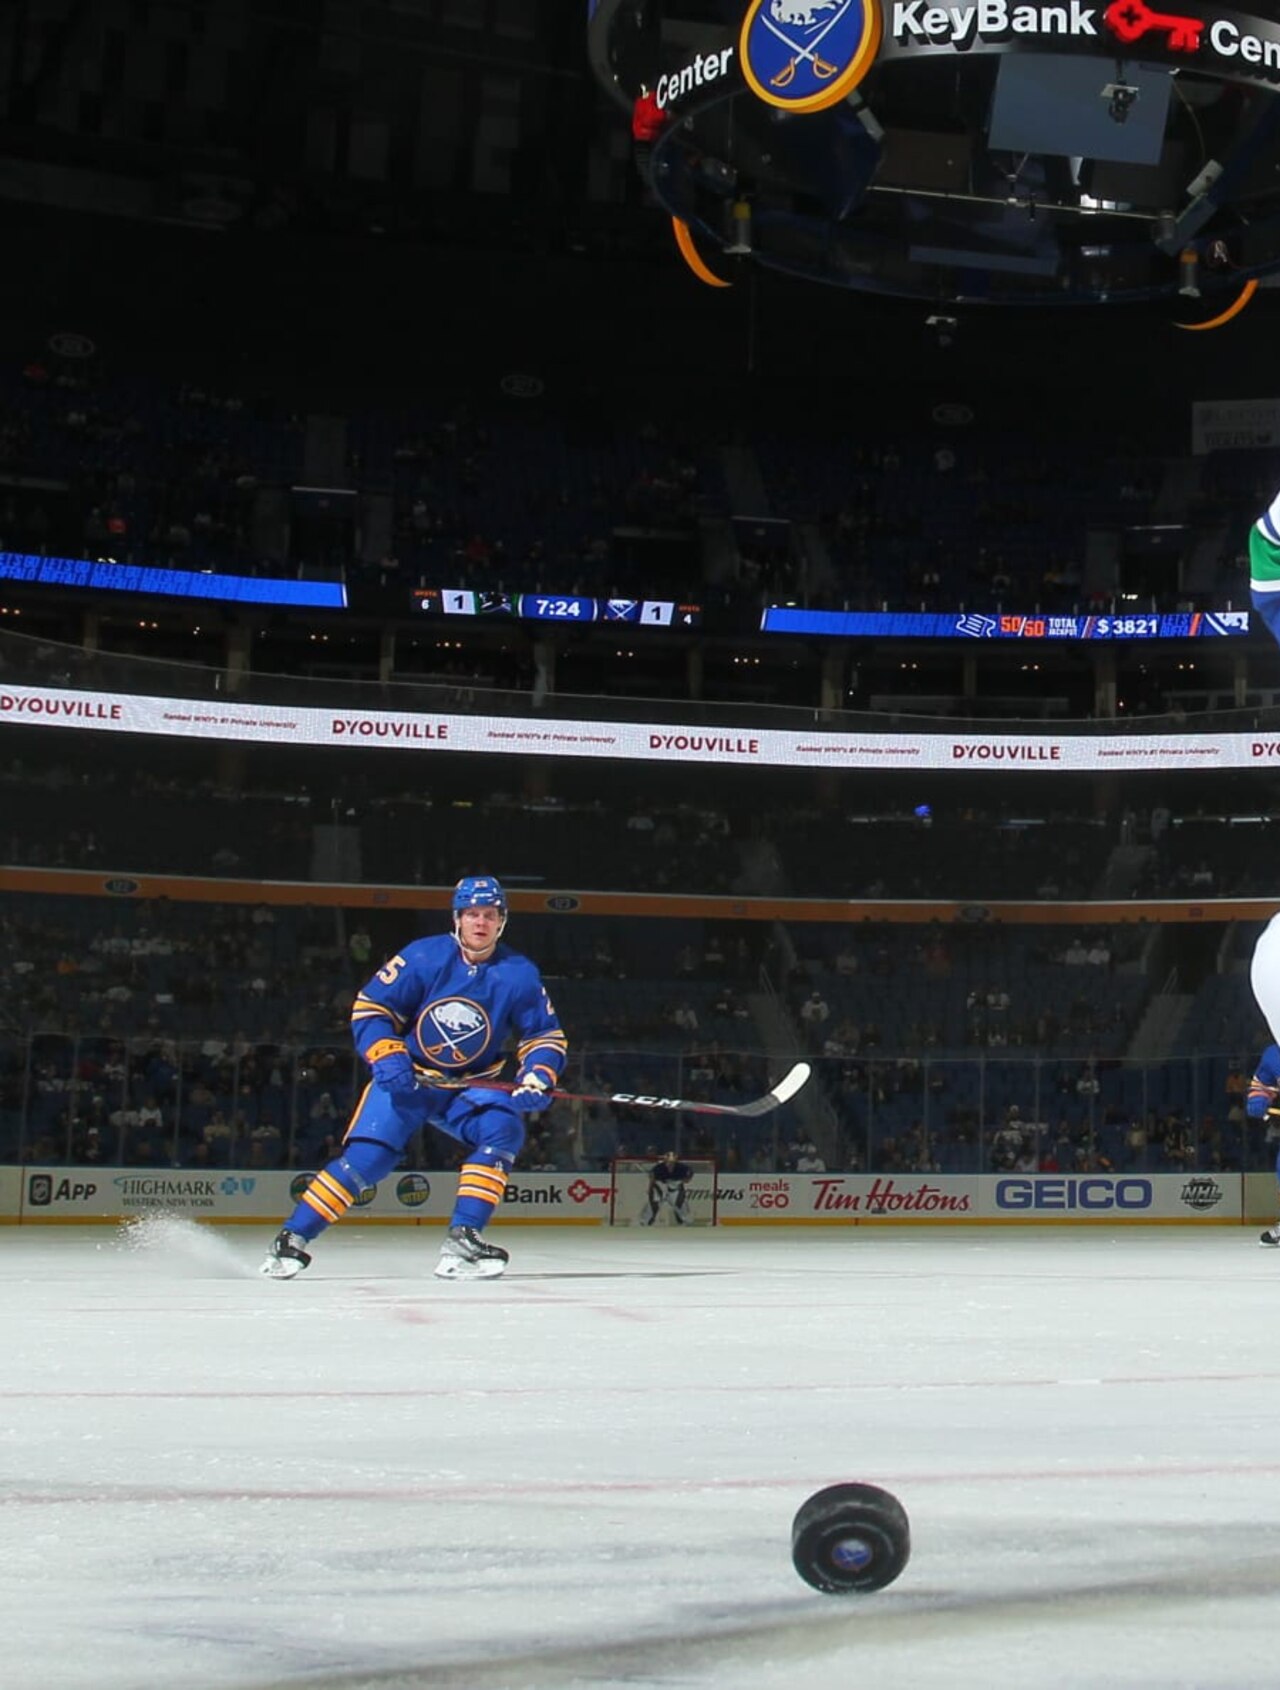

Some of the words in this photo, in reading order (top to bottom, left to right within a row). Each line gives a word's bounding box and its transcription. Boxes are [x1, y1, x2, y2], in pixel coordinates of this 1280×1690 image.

[893, 0, 1097, 40] KeyBank
[655, 47, 734, 110] Center
[453, 595, 463, 610] 1
[536, 599, 581, 617] 7:24
[652, 606, 661, 621] 1
[683, 613, 692, 625] 4
[1049, 618, 1077, 628] TOTAL
[1097, 618, 1109, 635] $
[1112, 619, 1158, 635] 3821
[611, 1093, 681, 1109] CCM
[54, 1178, 97, 1201] App
[122, 1178, 216, 1196] HIGHMARK
[503, 1184, 562, 1204] Bank
[749, 1179, 790, 1194] meals
[995, 1178, 1152, 1210] GEICO
[1181, 1184, 1222, 1200] NHL
[750, 1193, 789, 1210] 2GO
[812, 1179, 860, 1211] Tim
[865, 1178, 971, 1213] Hortons
